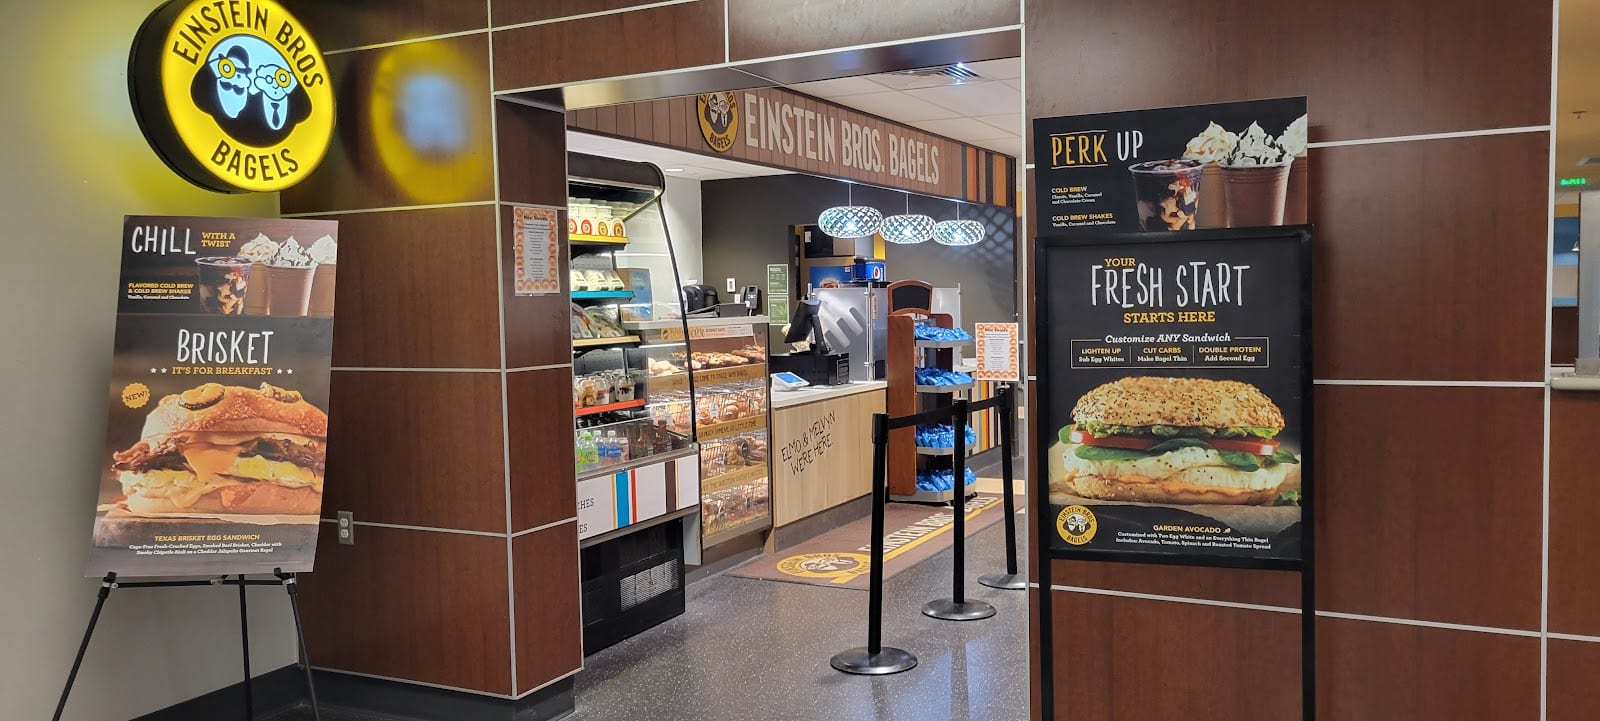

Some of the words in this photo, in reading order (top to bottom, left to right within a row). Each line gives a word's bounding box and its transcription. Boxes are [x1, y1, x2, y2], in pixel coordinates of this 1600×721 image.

[172, 0, 269, 65] EINSTEIN
[275, 20, 323, 87] BROS
[710, 132, 731, 148] BAGELS
[744, 93, 836, 165] EINSTEIN
[841, 119, 885, 173] BROS.
[889, 133, 940, 185] BAGELS
[1052, 133, 1108, 166] PERK
[1117, 130, 1144, 162] UP
[210, 140, 299, 181] BAGELS
[131, 225, 197, 256] CHILL
[201, 232, 227, 240] WITH
[229, 232, 236, 240] A
[201, 240, 231, 248] TWIST
[1104, 257, 1136, 267] YOUR
[1091, 262, 1163, 308] FRESH
[1176, 261, 1250, 308] START
[1124, 312, 1175, 324] STARTS
[1177, 311, 1216, 323] HERE
[1105, 334, 1155, 343] Customize
[1156, 333, 1181, 343] ANY
[1182, 332, 1231, 343] Sandwich
[177, 328, 274, 364] BRISKET
[1154, 355, 1172, 363] Bagel
[1242, 354, 1255, 362] Egg
[171, 366, 191, 375] IT'S
[193, 366, 214, 375] FOR
[215, 366, 273, 375] BREAKFAST
[125, 390, 148, 402] NEW!
[781, 439, 802, 462] ELMO
[802, 432, 809, 448] &
[808, 410, 836, 441] MELVYN
[790, 449, 814, 476] WERE
[814, 433, 832, 458] HERE
[1059, 506, 1082, 522] EINSTEIN
[1082, 508, 1095, 523] BROS
[1184, 526, 1221, 534] AVOCADO
[1066, 535, 1088, 543] BAGELS
